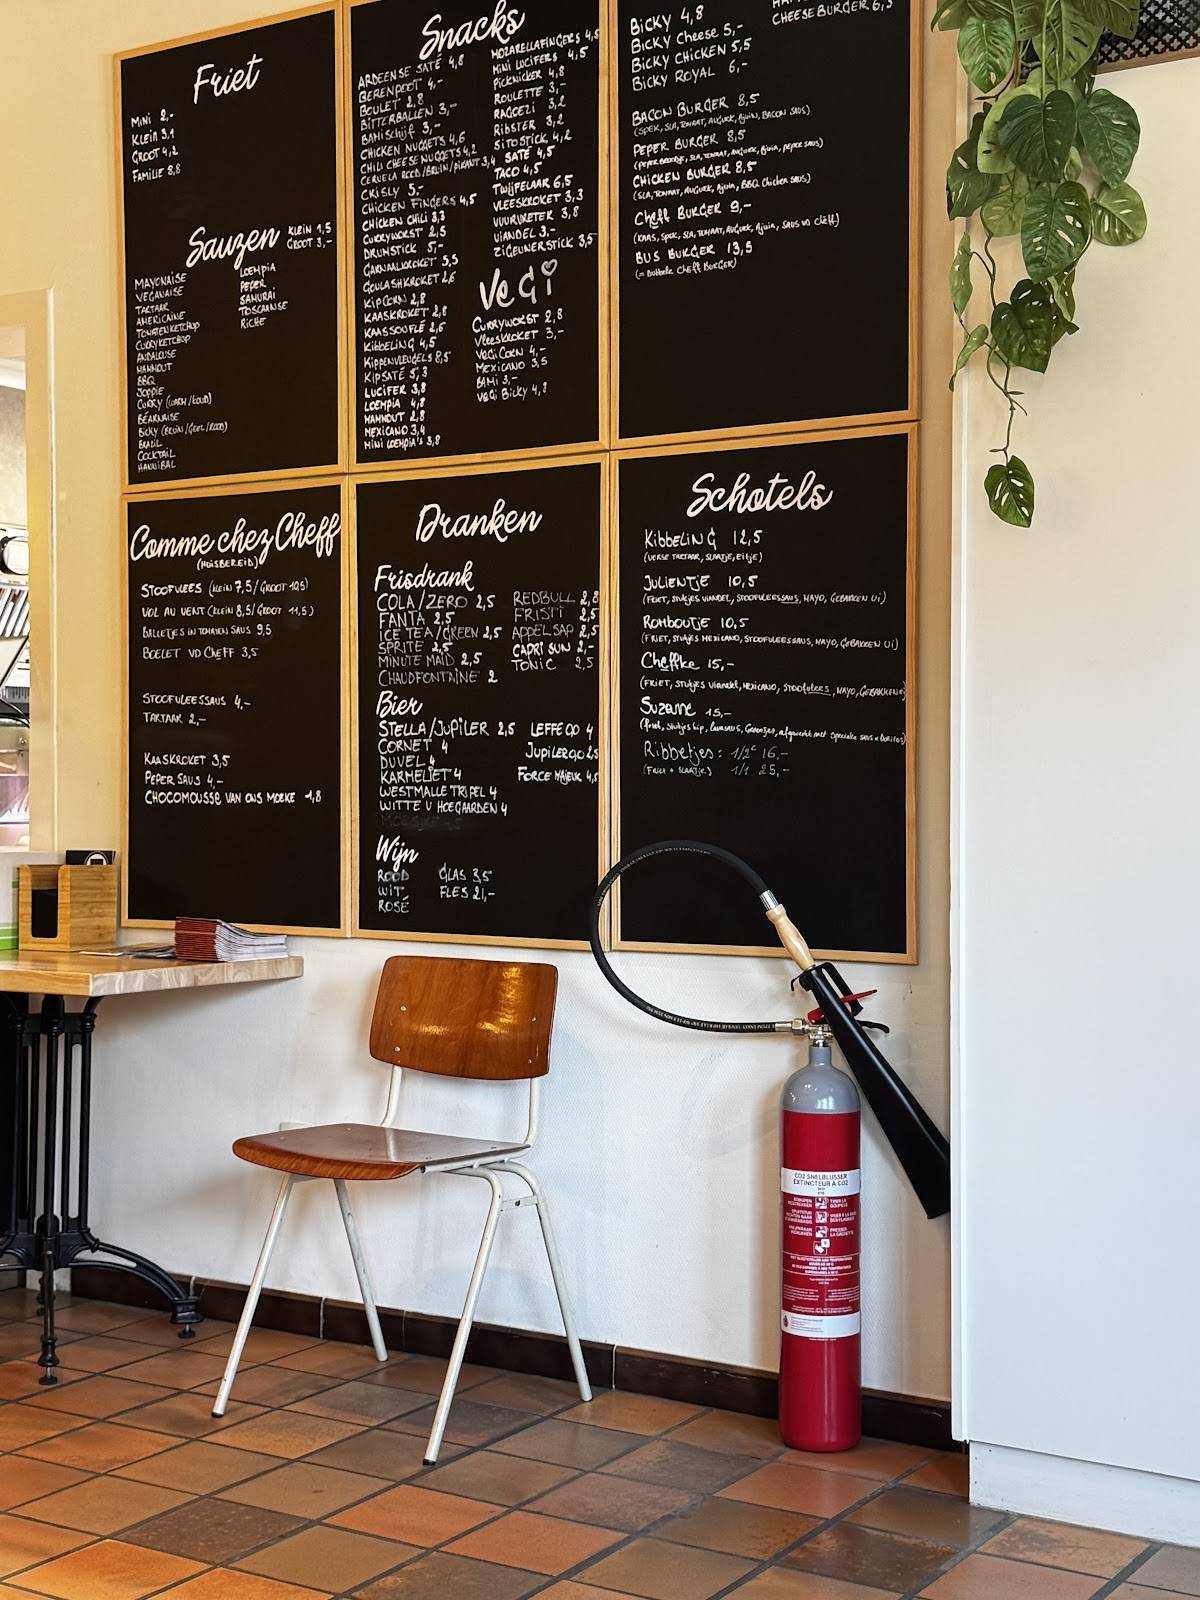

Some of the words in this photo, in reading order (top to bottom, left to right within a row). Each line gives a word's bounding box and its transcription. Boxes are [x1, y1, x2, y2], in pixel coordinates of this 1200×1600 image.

[681, 5, 704, 25] 4,8
[419, 0, 526, 62] Snacks
[676, 28, 719, 45] Cheese
[731, 37, 752, 53] 5,5
[568, 46, 589, 60] 4,5
[194, 54, 263, 104] Friet
[358, 66, 411, 90] ARDEENSE
[449, 54, 464, 70] 4,8
[549, 65, 565, 79] 4,8
[675, 67, 715, 84] ROYAL
[494, 86, 544, 105] ROULETTE
[632, 106, 672, 126] BACON
[677, 96, 729, 117] BURGER
[738, 93, 760, 107] 8,5
[546, 113, 564, 128] 3,2
[449, 131, 465, 146] 4,6
[727, 129, 746, 142] 8,5
[537, 145, 555, 159] 4,5
[633, 142, 669, 157] PEPER
[675, 133, 719, 150] BURGER
[132, 148, 160, 165] GROOT
[167, 163, 181, 176] 8,8
[494, 166, 520, 180] TACO
[523, 161, 542, 176] 4,5
[687, 163, 731, 180] BURGER
[735, 160, 757, 174] 8,5
[553, 174, 573, 188] 6,5
[565, 188, 583, 203] 3,3
[431, 210, 445, 224] 3,3
[678, 202, 722, 220] BURGER
[316, 222, 331, 235] 1,5
[428, 225, 446, 238] 2,5
[186, 226, 280, 272] Sauzen
[636, 250, 660, 264] BUS
[668, 244, 715, 259] BURGER
[727, 241, 752, 256] 13,5
[432, 304, 447, 318] 2,8
[545, 308, 563, 324] 2,8
[420, 336, 437, 351] 4,5
[531, 356, 548, 368] 3,5
[409, 366, 428, 381] 5,3
[411, 382, 426, 396] 3,8
[411, 397, 426, 410] 4,8
[410, 424, 425, 438] 3,4
[686, 470, 833, 517] Schotels
[416, 498, 543, 542] Dranken
[130, 525, 215, 562] Comme
[217, 518, 274, 567] chez
[275, 512, 343, 558] Cheff
[734, 529, 763, 546] 12,5
[374, 560, 475, 592] Frisdrank
[729, 575, 758, 588] 10,5
[476, 594, 495, 611] 2,5
[513, 591, 576, 606] REDBULL
[580, 590, 599, 607] 2,8
[142, 607, 159, 618] VOL
[181, 607, 205, 616] VENT
[379, 610, 425, 629] FANTA
[434, 611, 455, 625] 2,5
[579, 607, 599, 622] 2,5
[257, 624, 272, 636] 9,5
[721, 617, 749, 630] 10,5
[380, 628, 401, 642] ICE
[483, 626, 502, 640] 2,5
[579, 624, 599, 639] 2,5
[143, 646, 181, 660] BOELET
[188, 648, 202, 658] VD
[242, 646, 259, 659] 3,5
[378, 640, 424, 654] SPRITE
[432, 640, 453, 655] 2,5
[548, 642, 571, 655] SUN
[461, 652, 482, 667] 2,5
[575, 656, 594, 671] 2,5
[488, 670, 498, 683] 2
[376, 690, 423, 718] Bier
[498, 721, 515, 737] 2,5
[531, 722, 563, 737] LEFFE
[378, 736, 432, 755] CORNET
[442, 739, 448, 754] 4
[144, 752, 206, 765] KAASKROKET
[212, 754, 230, 768] 3,5
[380, 755, 426, 770] DUVEL
[429, 754, 435, 766] 4
[145, 770, 175, 786] PEPER
[177, 773, 201, 786] SAUS
[454, 768, 461, 781] 4
[518, 766, 552, 782] FORCE
[225, 792, 241, 804] VAN
[245, 792, 263, 804] ONS
[379, 785, 447, 799] WESTMALLE
[489, 786, 497, 800] 4
[379, 800, 422, 811] WITTE
[437, 800, 498, 815] HOEGAARDEN
[501, 802, 507, 816] 4
[376, 834, 419, 873] Wijn
[377, 869, 409, 882] ROOD
[439, 862, 466, 883] GLAS
[473, 868, 492, 884] 3,5
[440, 885, 469, 898] FLES
